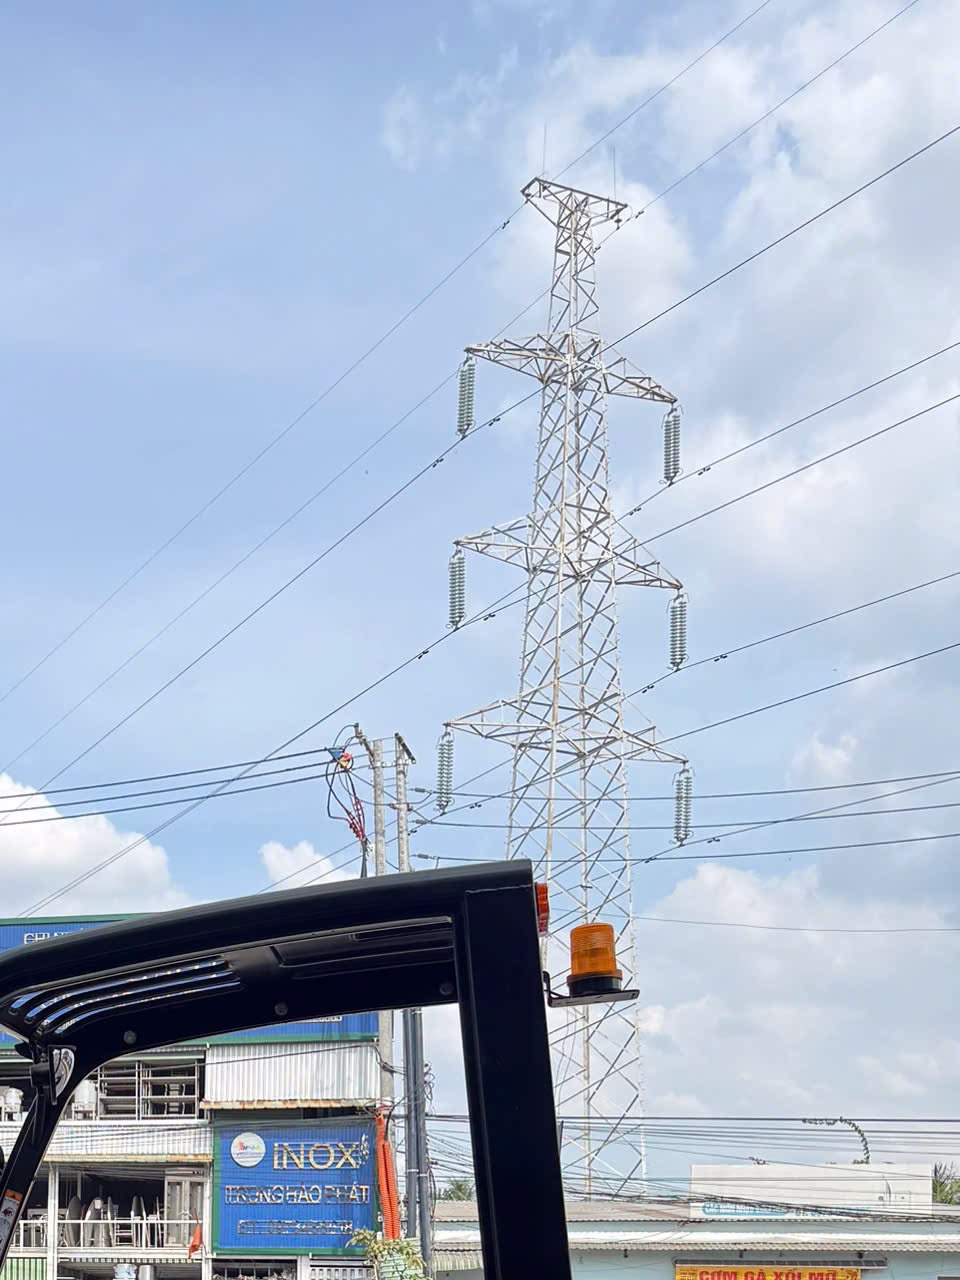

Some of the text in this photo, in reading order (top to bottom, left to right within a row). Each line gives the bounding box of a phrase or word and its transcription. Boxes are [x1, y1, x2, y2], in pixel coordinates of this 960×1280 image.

[273, 1142, 360, 1169] INOX
[225, 1181, 370, 1204] TRUNG HÀO PHÁT
